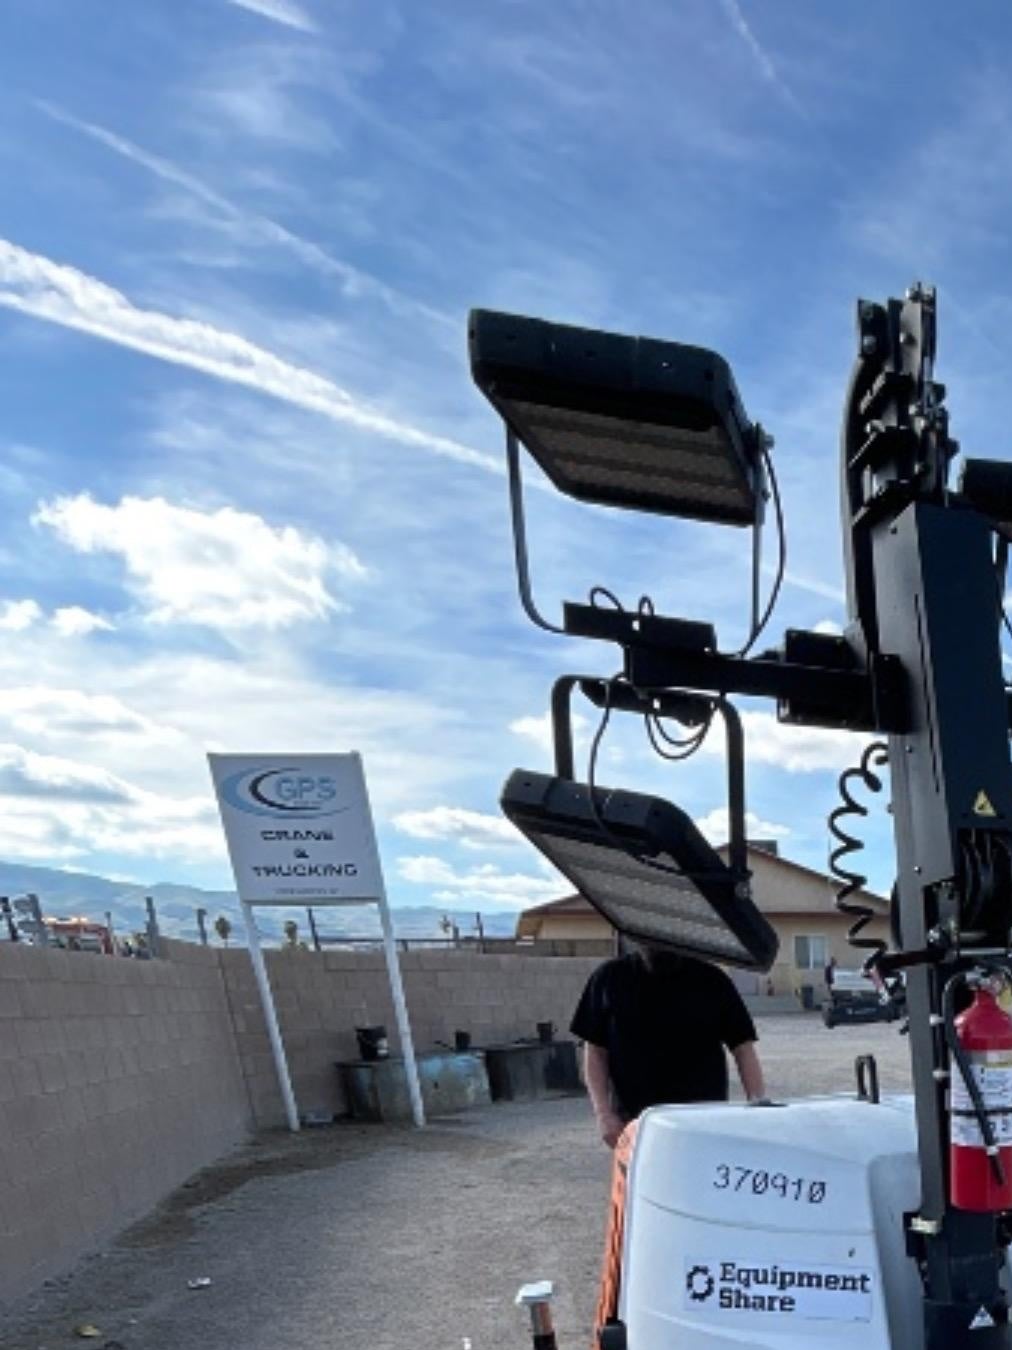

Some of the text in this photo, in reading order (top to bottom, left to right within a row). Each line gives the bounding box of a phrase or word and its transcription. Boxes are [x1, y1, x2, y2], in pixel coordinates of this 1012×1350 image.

[276, 776, 337, 801] GPS
[260, 829, 334, 841] CRANE
[294, 848, 310, 859] &
[252, 863, 358, 877] TRUCKING
[713, 1163, 827, 1204] 370910
[719, 1262, 871, 1293] Equipment
[719, 1286, 796, 1312] Share
